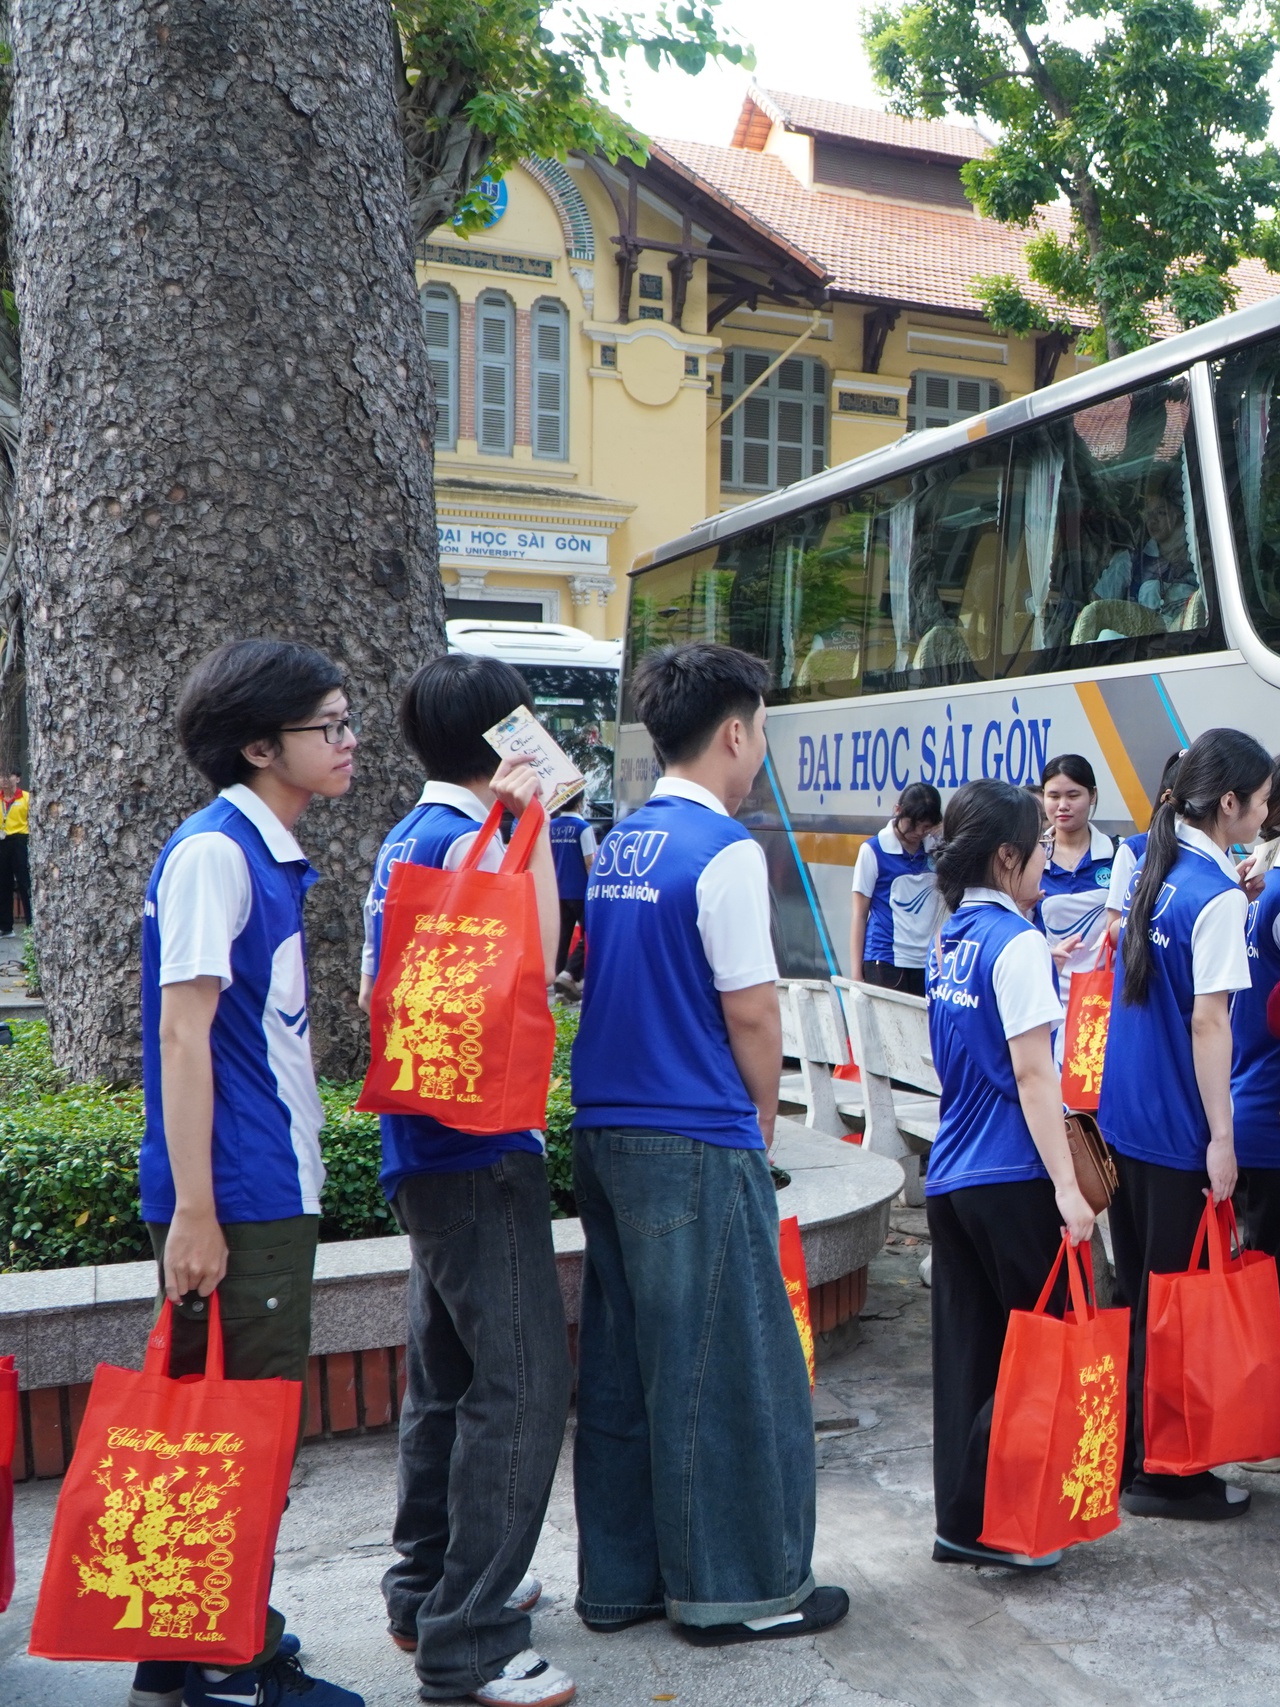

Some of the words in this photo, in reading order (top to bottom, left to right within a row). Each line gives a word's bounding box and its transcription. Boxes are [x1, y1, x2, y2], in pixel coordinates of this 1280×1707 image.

[465, 547, 525, 558] UNIVERSITY
[471, 530, 507, 547] HỌC
[517, 532, 545, 549] SÀI
[555, 535, 591, 552] GÒN
[797, 733, 843, 805] ĐẠI
[850, 726, 910, 807] HỌC
[920, 703, 973, 789] SÀI
[981, 696, 1051, 786] GÒN
[595, 830, 669, 877] SGU
[601, 884, 621, 902] HỌC
[636, 881, 660, 904] GÒN
[952, 988, 979, 1009] GÒN
[107, 1426, 145, 1451] Chúc
